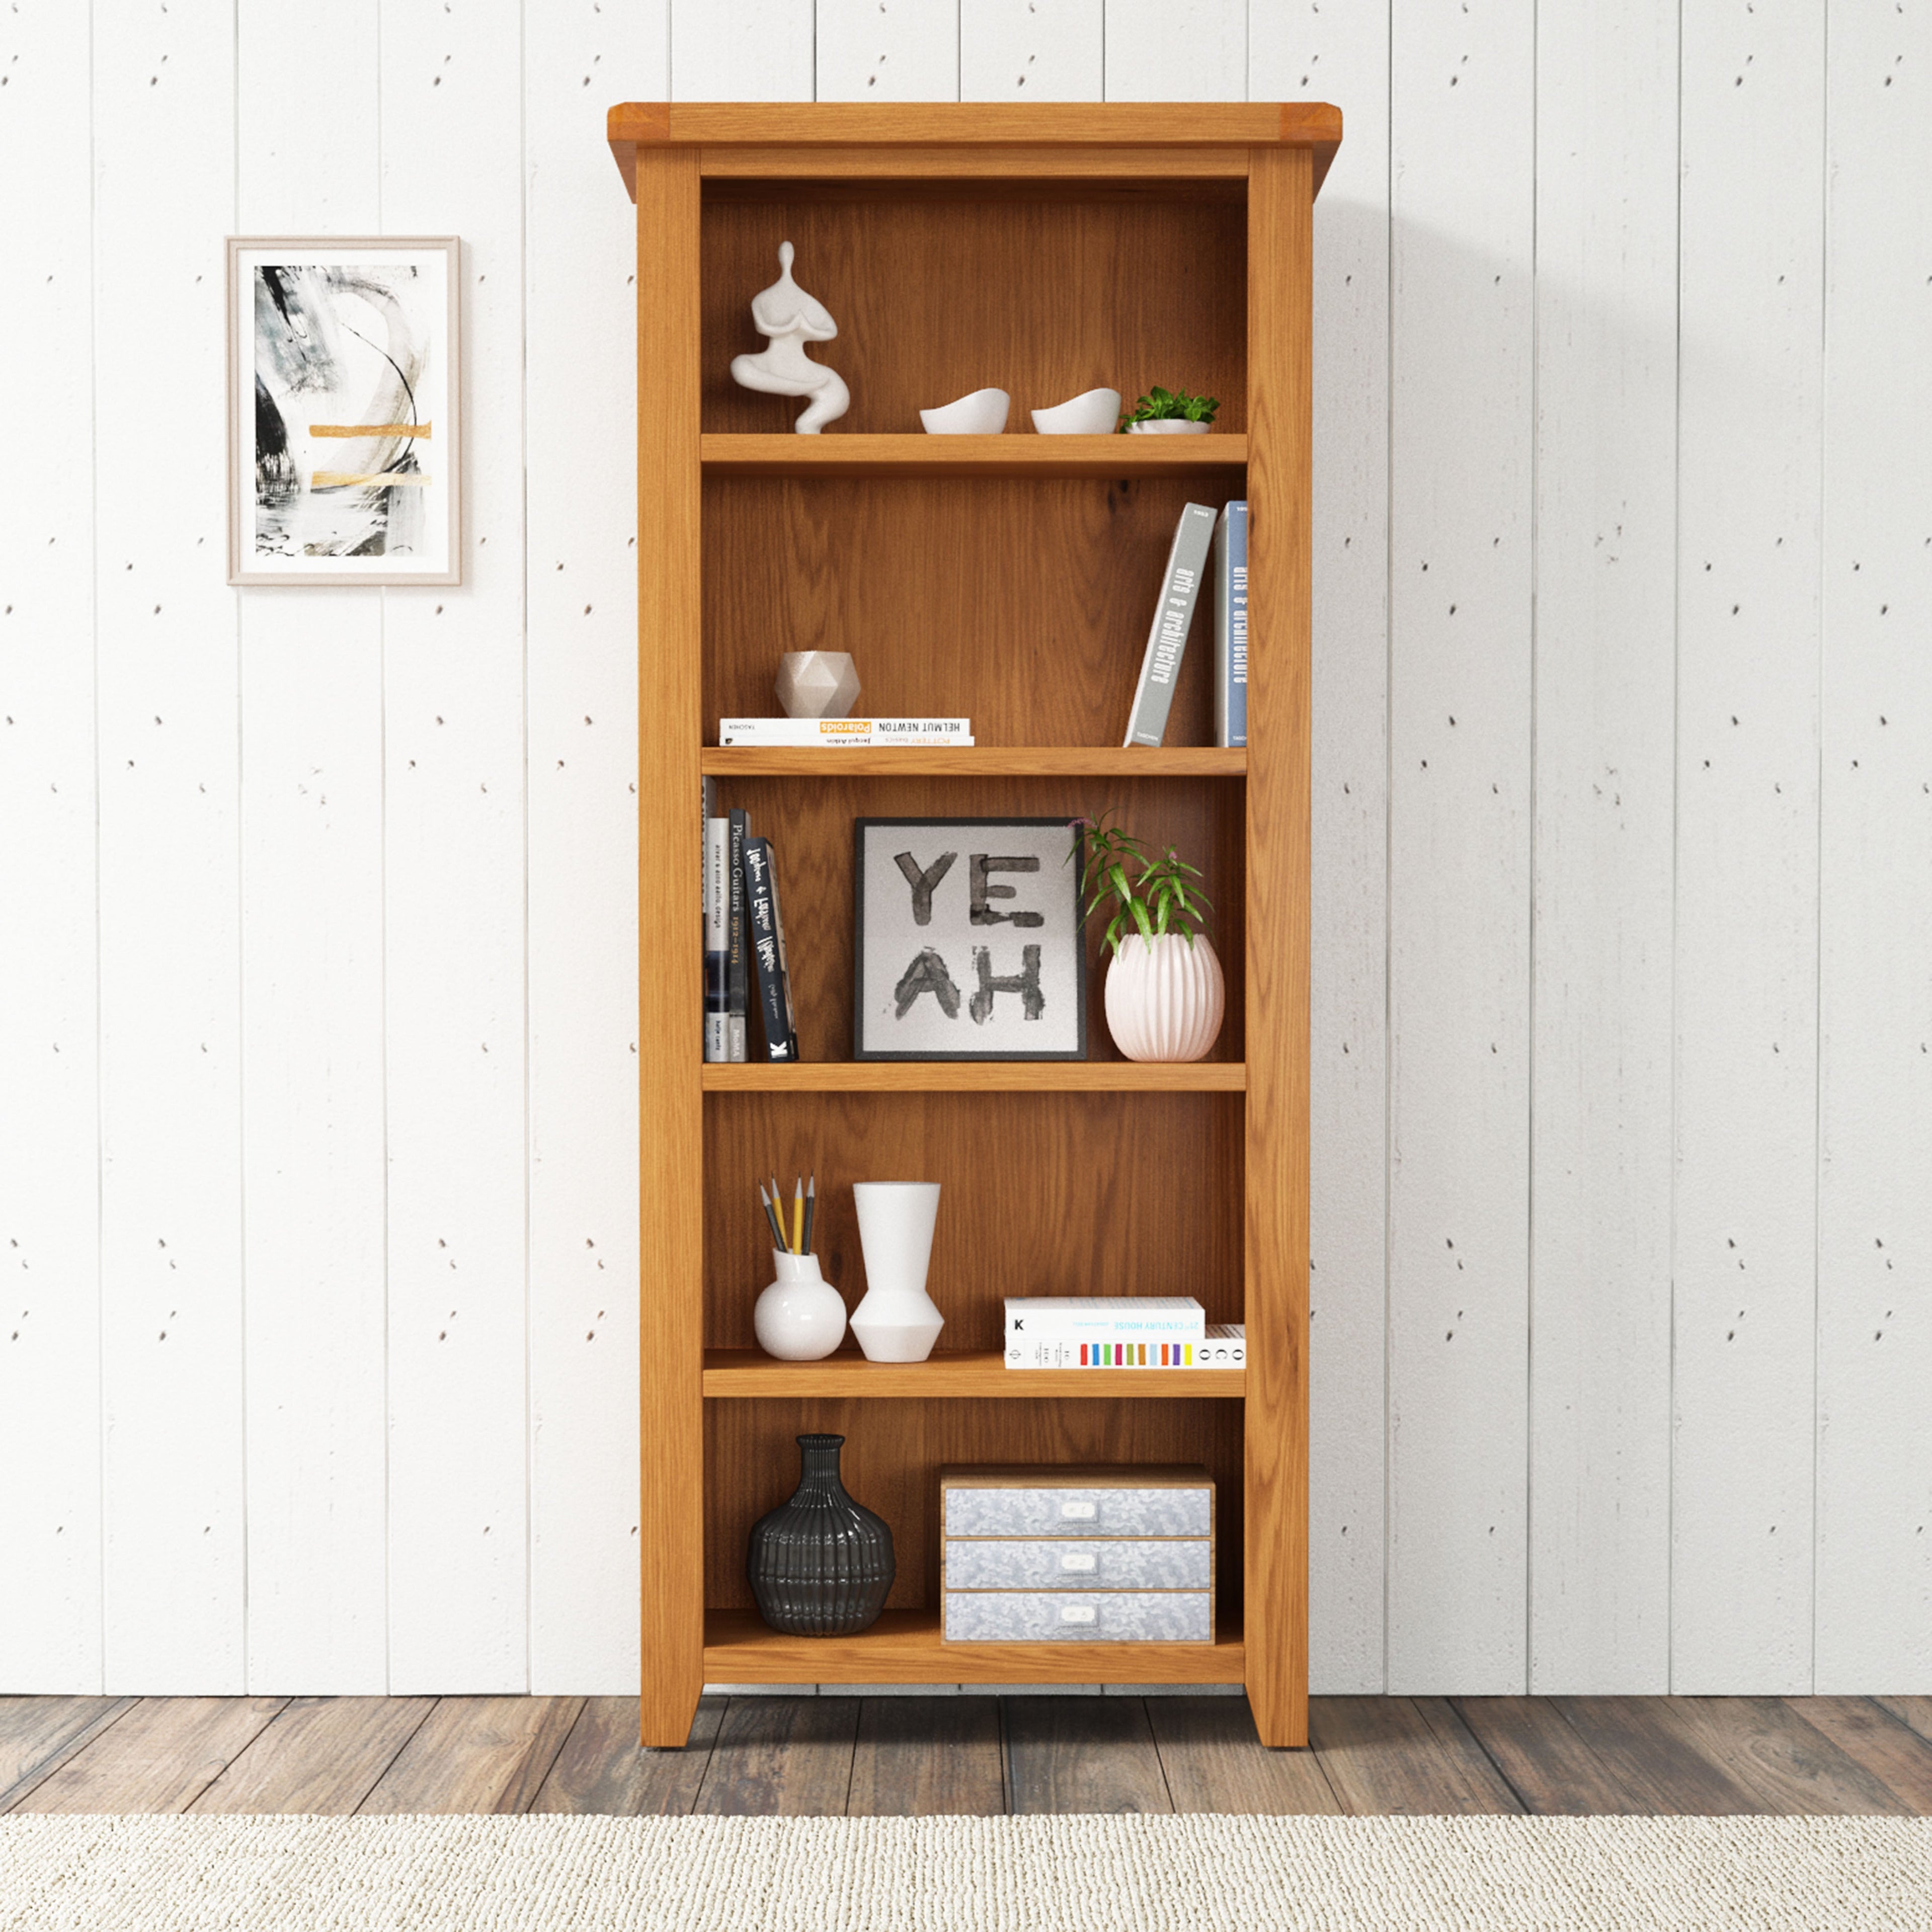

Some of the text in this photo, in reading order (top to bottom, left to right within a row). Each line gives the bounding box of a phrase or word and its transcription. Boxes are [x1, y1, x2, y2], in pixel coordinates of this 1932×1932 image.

[1150, 568, 1194, 684] arts & architecture
[821, 722, 960, 733] HELMUT NEWTON Polaroids
[733, 824, 743, 865] Picasso
[732, 867, 743, 912] Guitars
[1014, 1319, 1024, 1331] K
[1114, 1321, 1143, 1330] HOUSE
[1144, 1321, 1184, 1330] CENTURY
